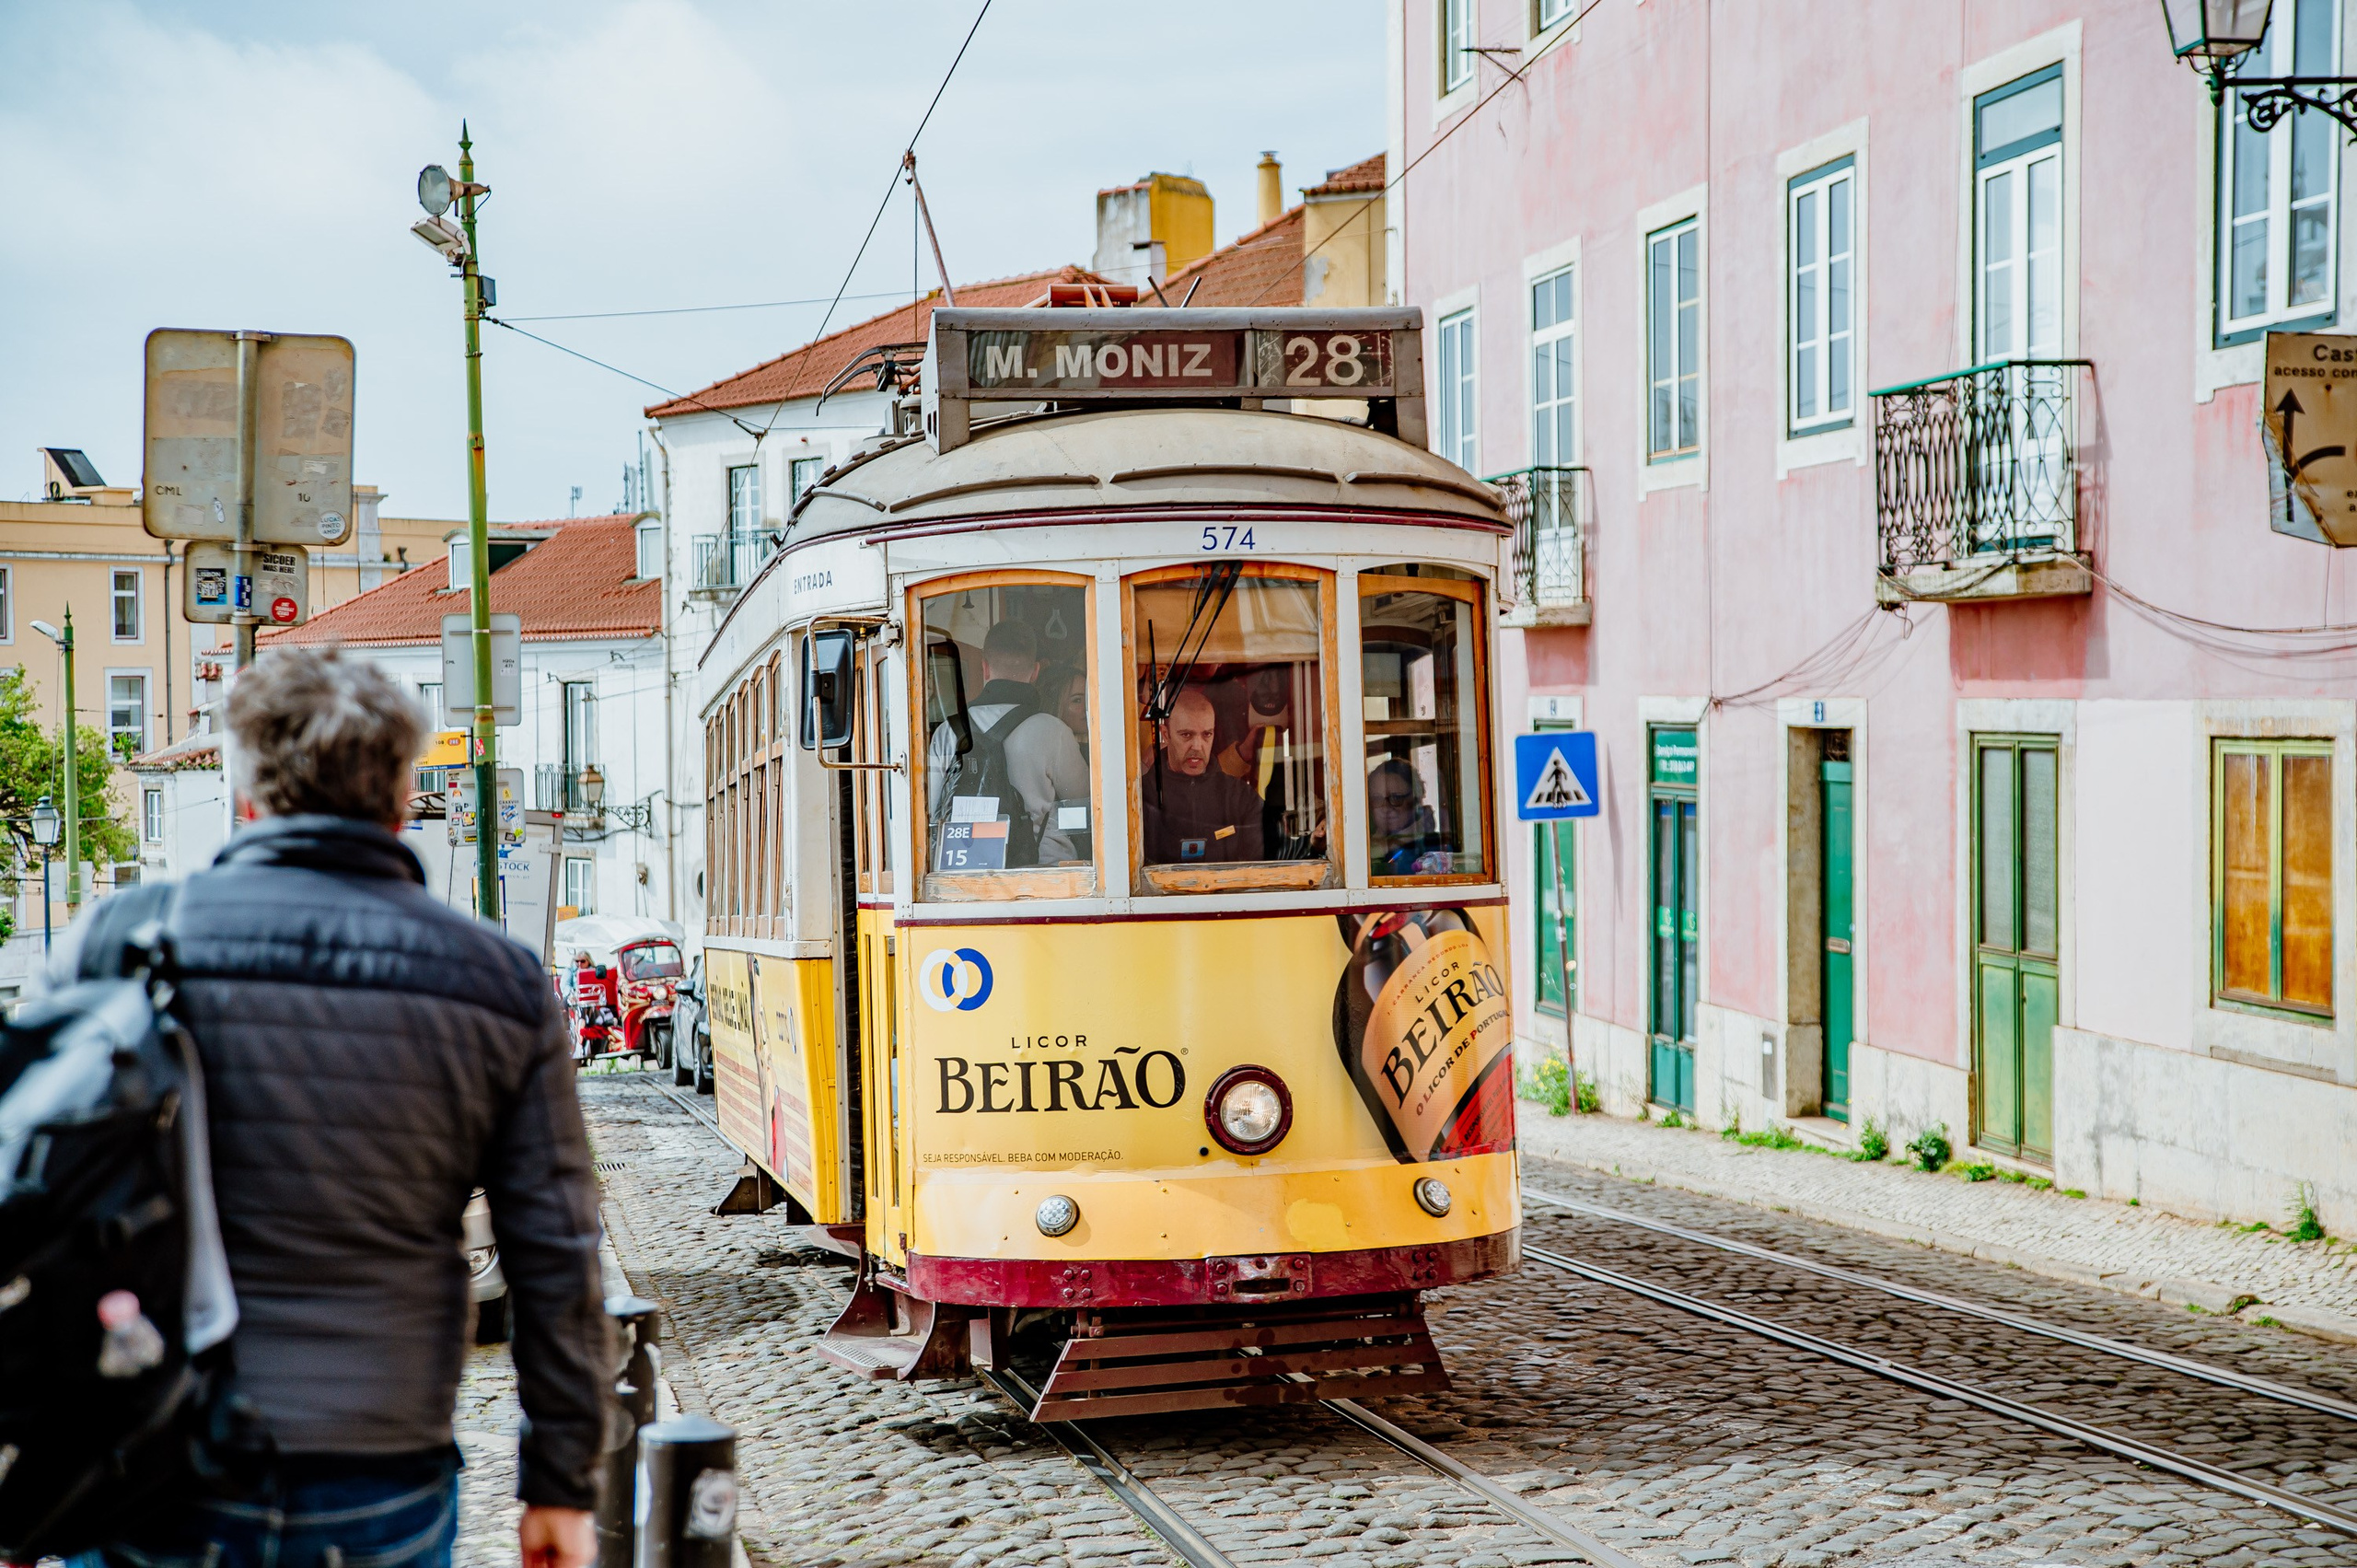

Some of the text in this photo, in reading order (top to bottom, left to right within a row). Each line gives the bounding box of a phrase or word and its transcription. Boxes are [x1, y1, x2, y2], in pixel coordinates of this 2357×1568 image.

[985, 343, 1213, 379] M. MONIZ
[1284, 335, 1365, 386] 28
[2313, 343, 2357, 362] Cas
[2274, 366, 2326, 378] acesso
[156, 485, 183, 496] CML
[1202, 526, 1257, 551] 574
[262, 564, 296, 575] WAS HERE
[794, 570, 832, 595] ENTRADA
[946, 827, 970, 839] 28E
[946, 849, 968, 866] 15
[1392, 965, 1426, 1005] CARRANCA
[1414, 961, 1460, 1004] LICOR
[1011, 1034, 1088, 1049] LICOR
[1381, 960, 1505, 1110] BEIRÃO
[935, 1045, 1187, 1114] BEIRÃO
[1422, 1056, 1455, 1105] LICOR
[1455, 1038, 1470, 1059] DE
[923, 1148, 1124, 1164] SEJA RESPONSÁVEL. BEBA COM MODERAÇÃO.
